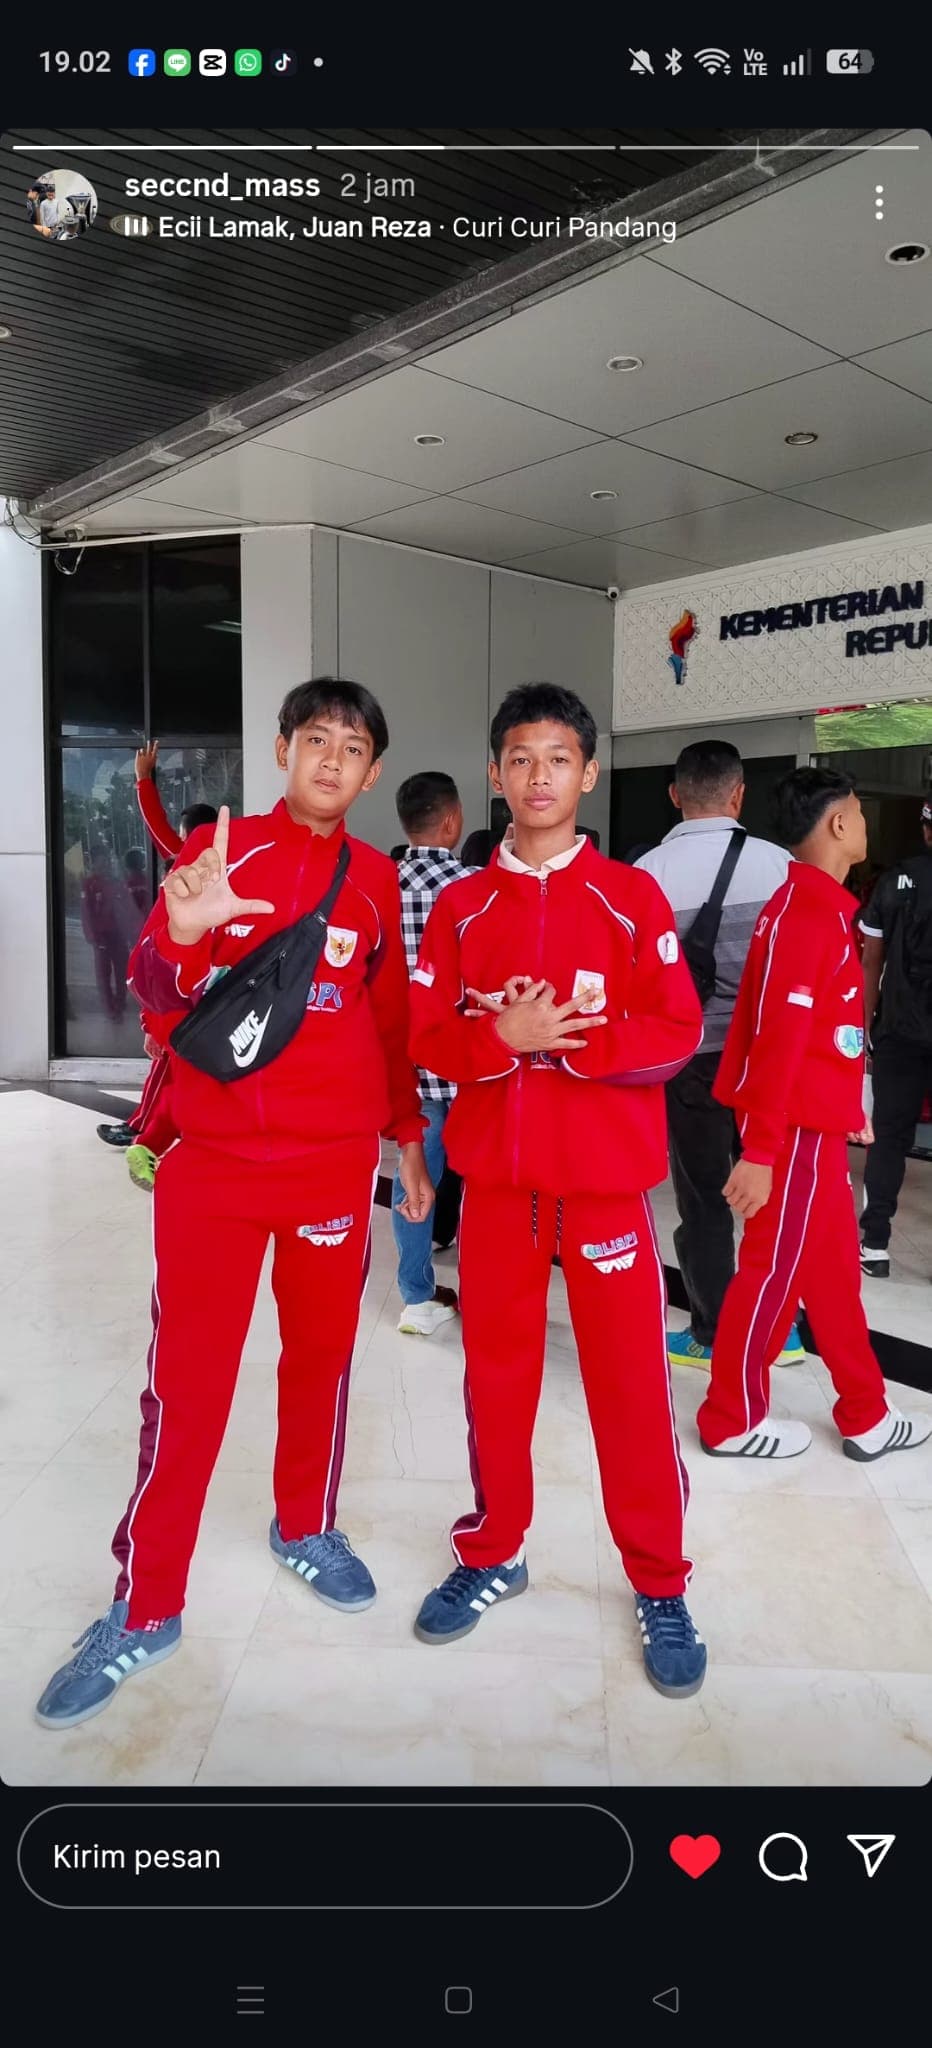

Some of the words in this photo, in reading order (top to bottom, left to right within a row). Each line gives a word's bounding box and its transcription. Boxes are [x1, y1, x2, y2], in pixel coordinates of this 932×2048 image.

[719, 580, 924, 641] KEMENTERIAN
[845, 618, 932, 658] REPU
[228, 1009, 263, 1055] NIKE
